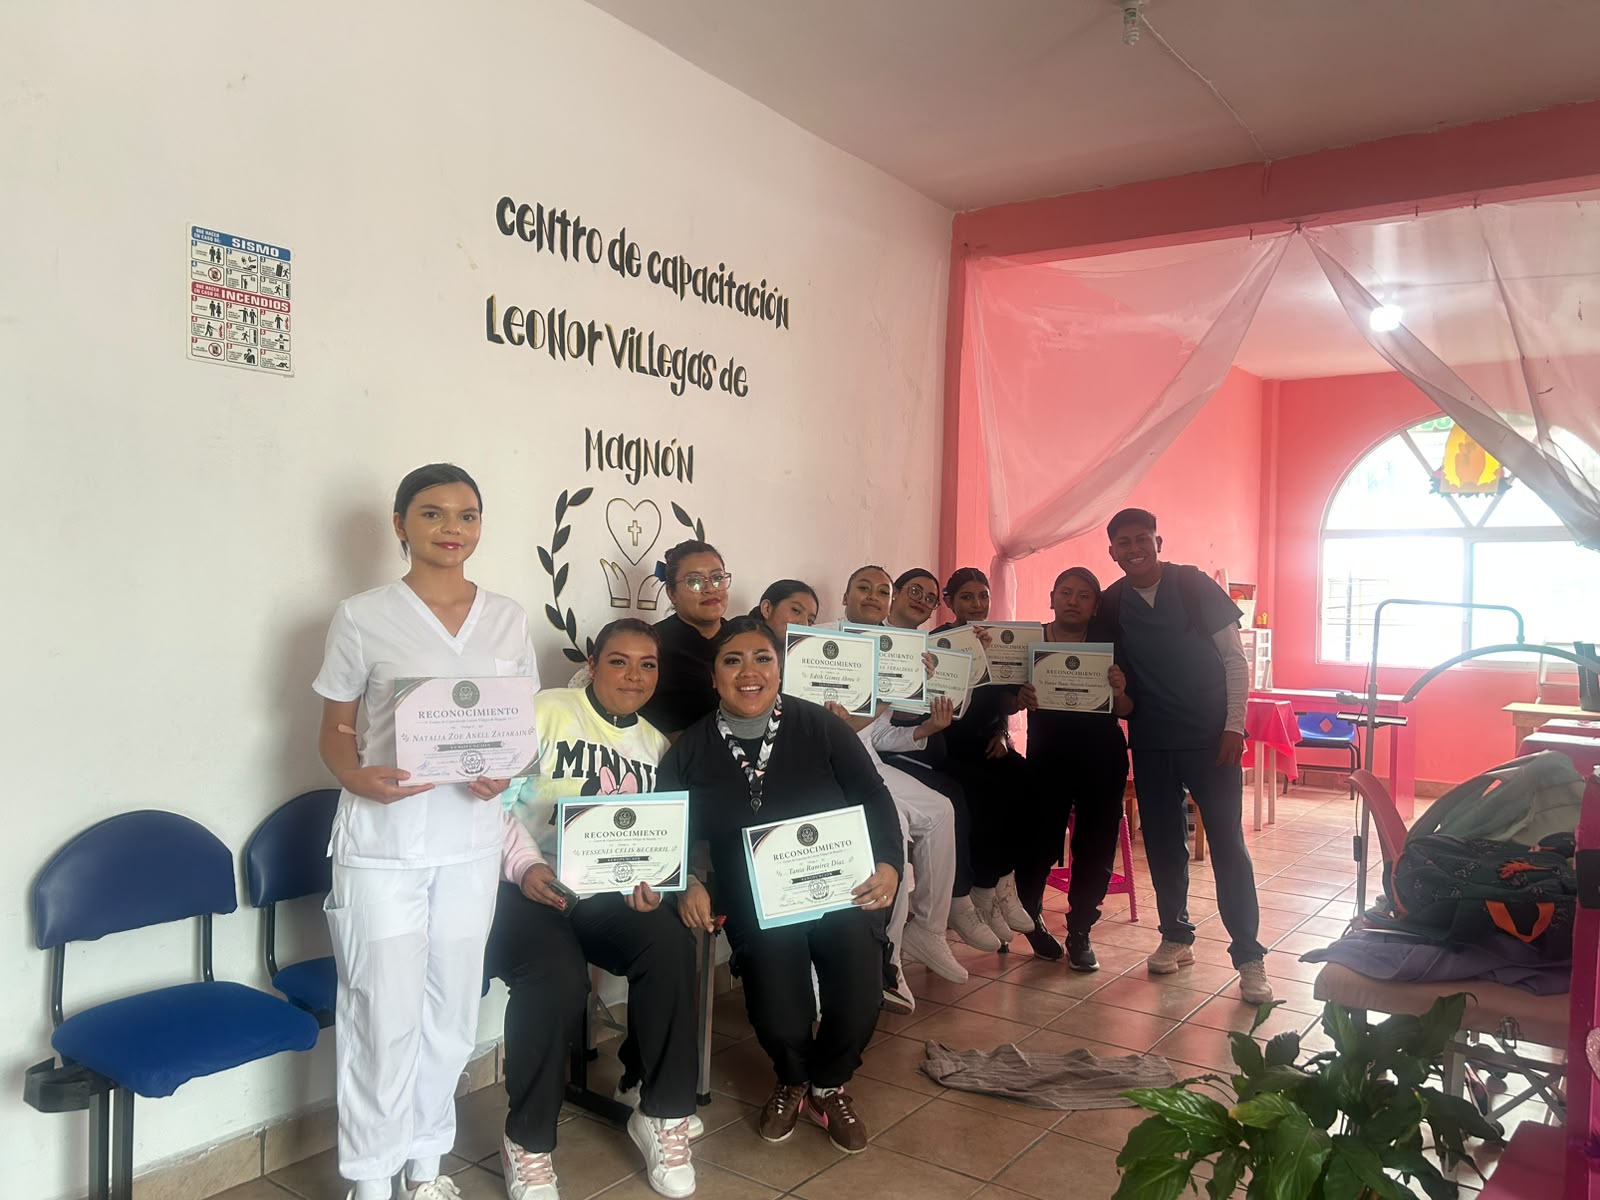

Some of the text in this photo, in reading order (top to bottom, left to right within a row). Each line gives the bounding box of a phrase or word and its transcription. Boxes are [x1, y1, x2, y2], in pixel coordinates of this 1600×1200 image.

[231, 238, 279, 257] SISMO
[608, 227, 642, 278] de
[221, 289, 289, 311] INCENDIOS
[719, 357, 748, 397] de
[801, 658, 862, 668] RECONOCIMIENTO
[1046, 669, 1101, 677] RECONOCIMIENTO
[418, 707, 519, 719] RECONOCIMIENTO
[552, 739, 658, 793] MINNI
[584, 829, 668, 839] RECONOCIMIENTO
[582, 848, 613, 856] YESSENIA
[773, 839, 852, 861] RECONOCIMIENTO
